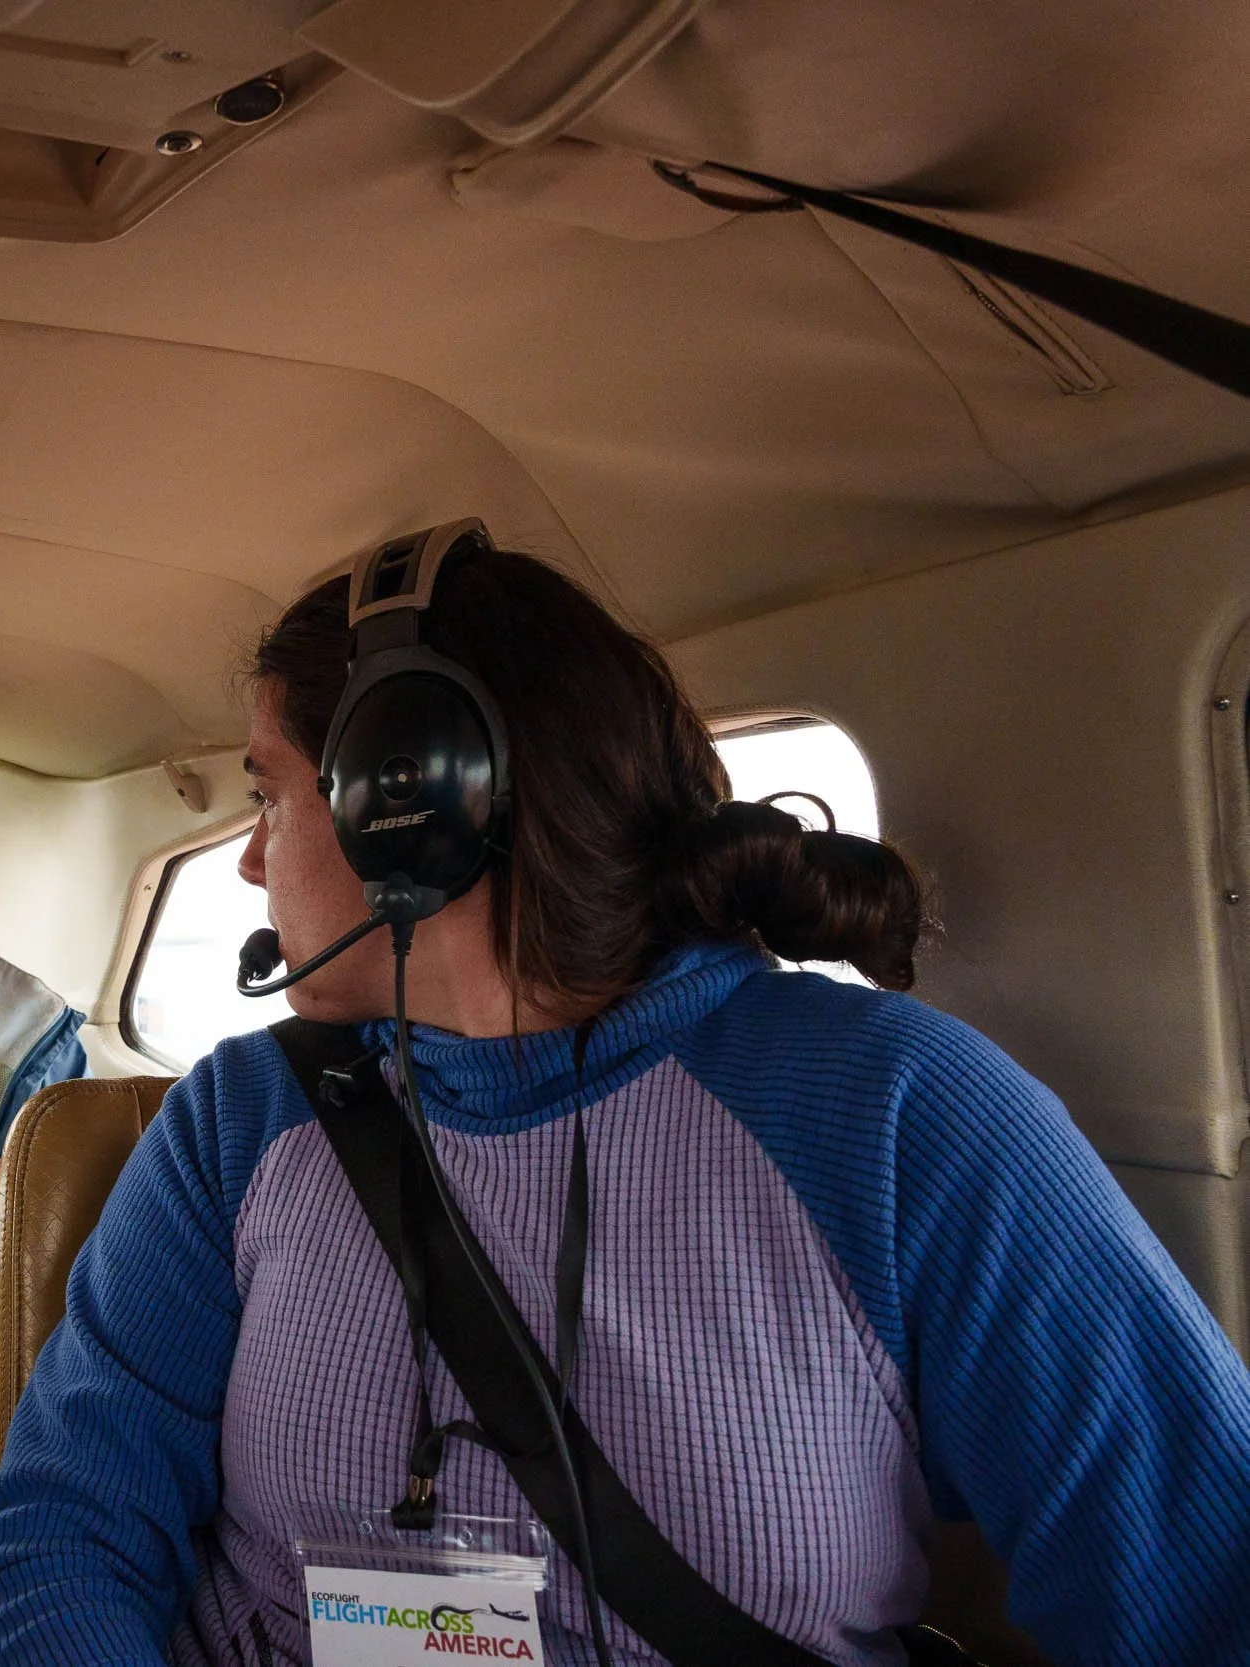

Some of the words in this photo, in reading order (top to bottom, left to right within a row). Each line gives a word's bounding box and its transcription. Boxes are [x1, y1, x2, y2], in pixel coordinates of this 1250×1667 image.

[362, 810, 434, 832] BOSE
[311, 1591, 361, 1604] ECOFLIGHT
[423, 1631, 535, 1661] AMERICA
